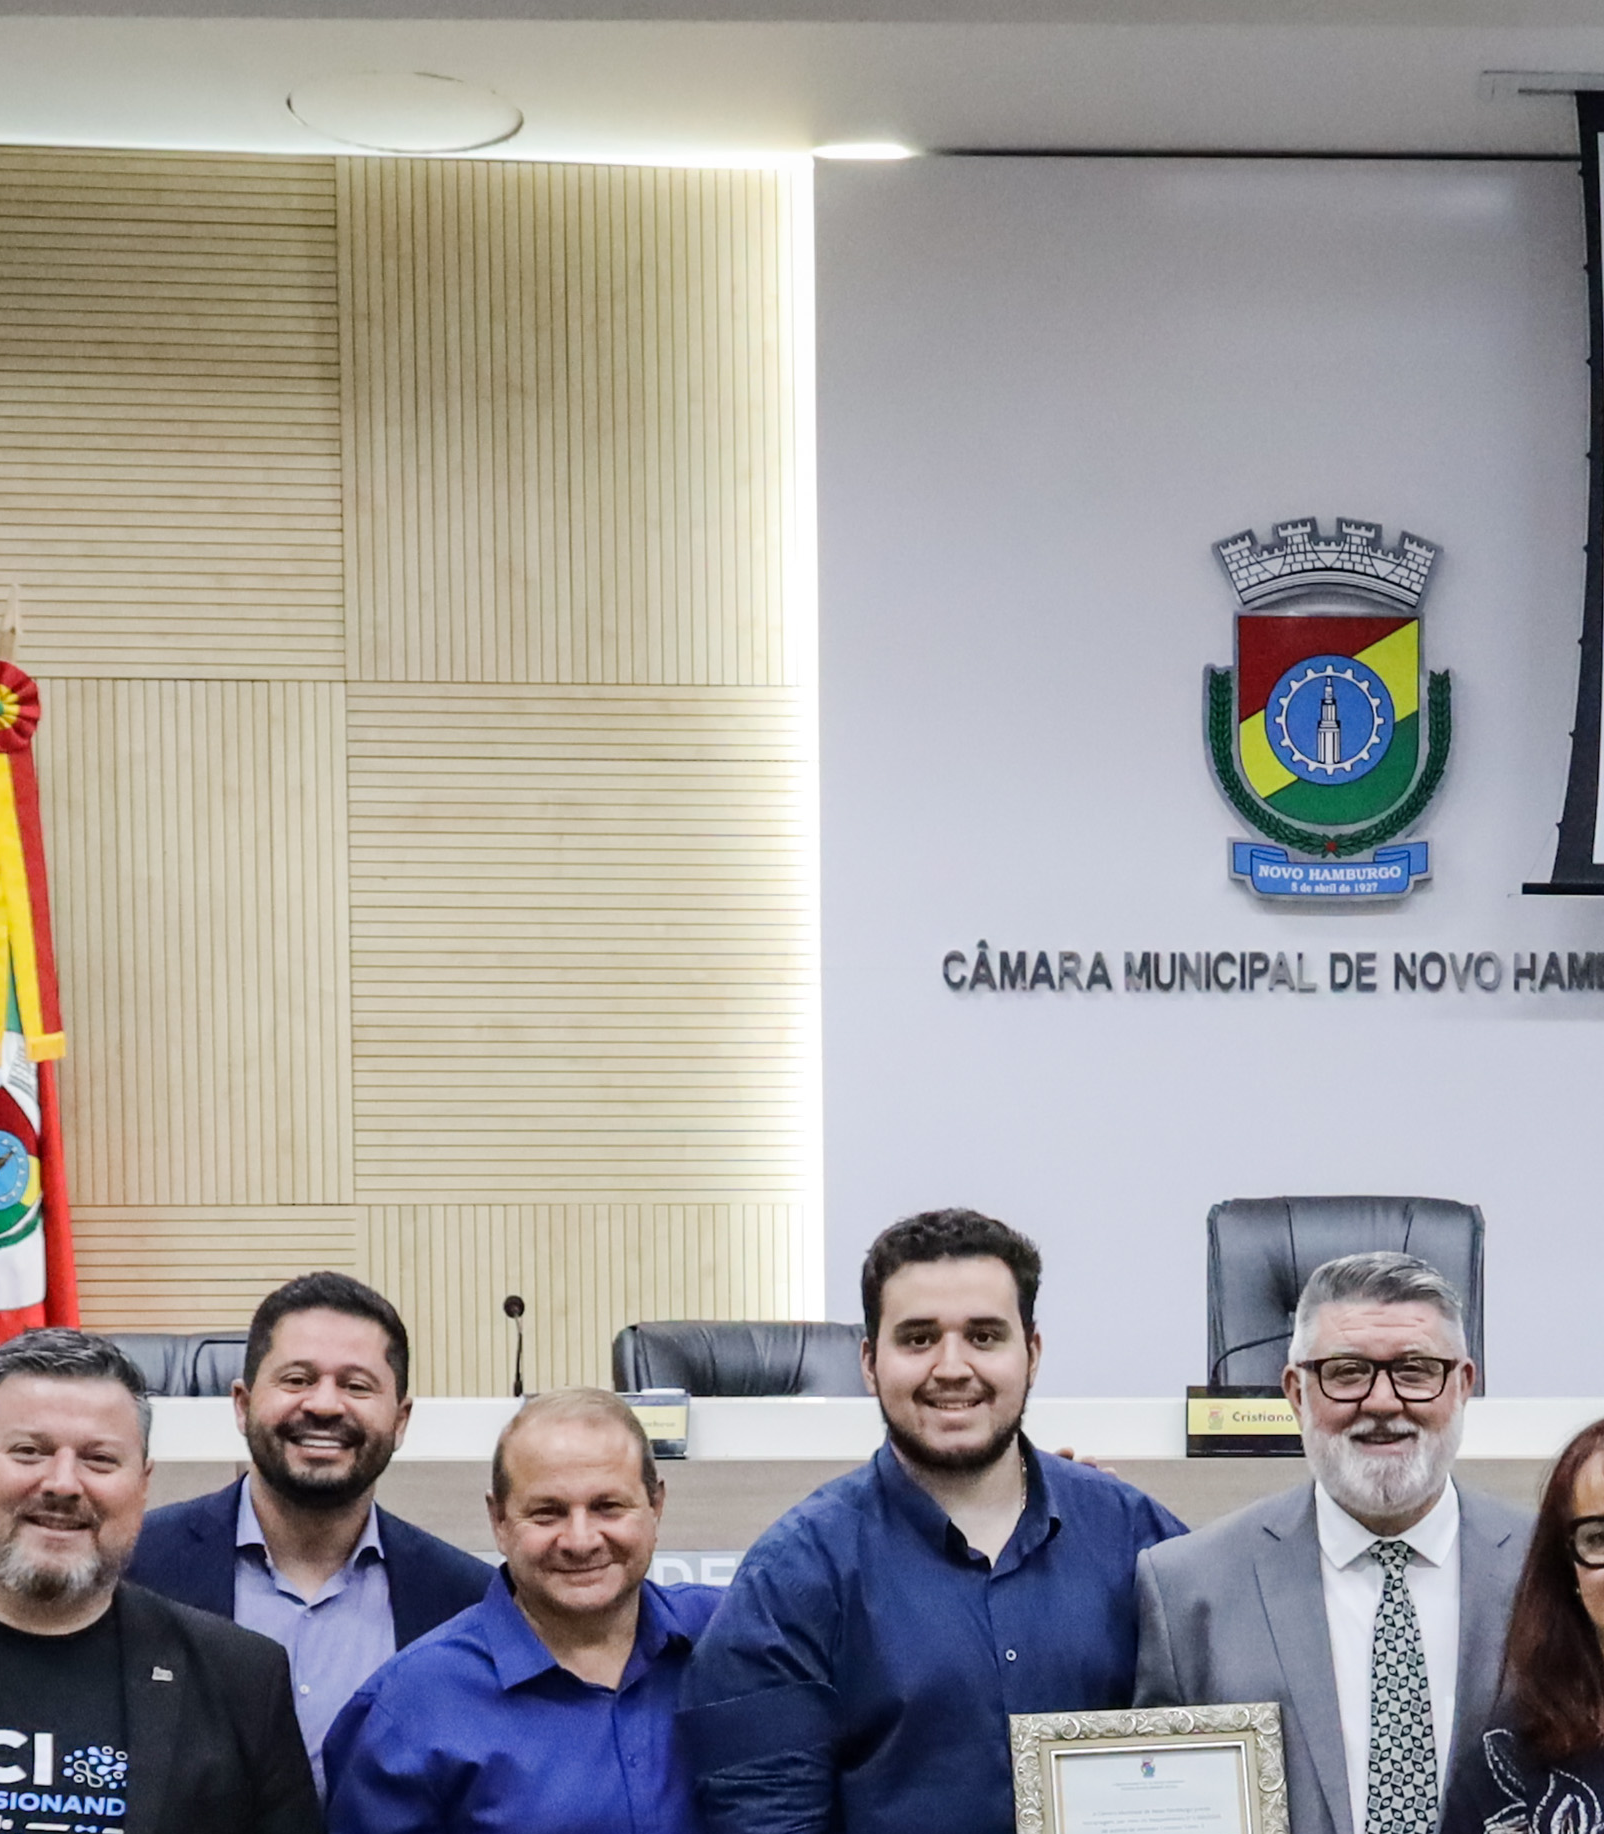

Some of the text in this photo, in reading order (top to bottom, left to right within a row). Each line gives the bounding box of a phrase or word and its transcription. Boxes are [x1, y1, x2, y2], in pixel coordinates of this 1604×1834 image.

[1258, 864, 1402, 881] NOVO HAMBURGO
[1300, 882, 1313, 893] de
[1338, 882, 1351, 893] de
[1353, 882, 1378, 893] 1927
[942, 938, 1113, 992] CÂMARA
[1123, 950, 1318, 993] MUNICIPAL
[1329, 951, 1378, 993] DE
[1393, 951, 1502, 994] NOVO
[1232, 1410, 1294, 1423] Cristiano
